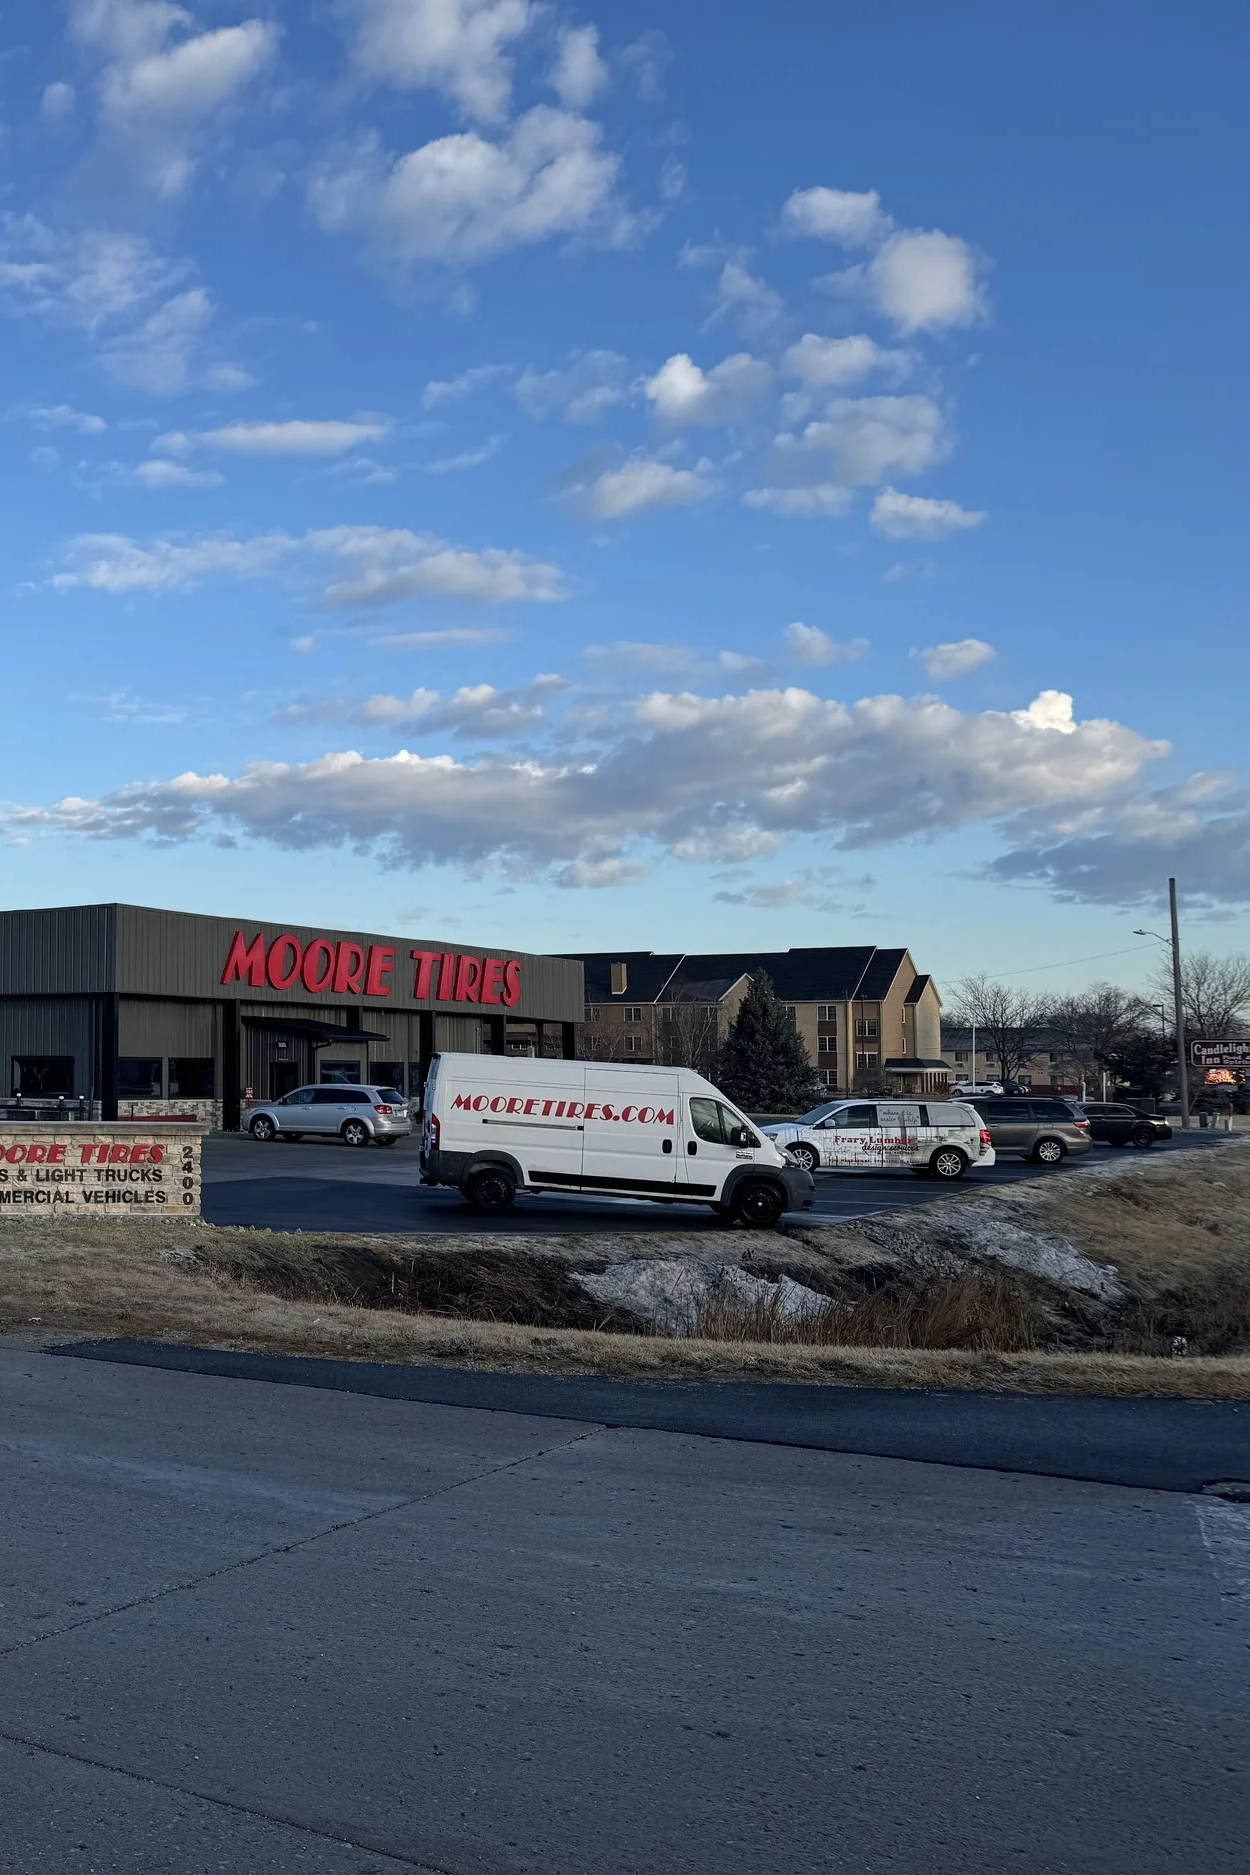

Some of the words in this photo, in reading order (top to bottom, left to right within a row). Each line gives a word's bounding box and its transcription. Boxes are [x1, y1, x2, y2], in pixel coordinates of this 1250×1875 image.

[220, 930, 397, 996] MOORE
[410, 949, 522, 1007] TIRES
[1201, 1055, 1221, 1065] Inn
[450, 1093, 675, 1126] MOORETIRES.COM
[834, 1136, 867, 1145] Frary
[869, 1136, 915, 1145] Lumber
[77, 1144, 166, 1164] TIRES
[16, 1168, 28, 1183] &
[35, 1168, 86, 1183] LIGHT
[93, 1168, 163, 1183] TRUCKS
[182, 1145, 194, 1206] 2400
[82, 1190, 166, 1205] VEHICLES
